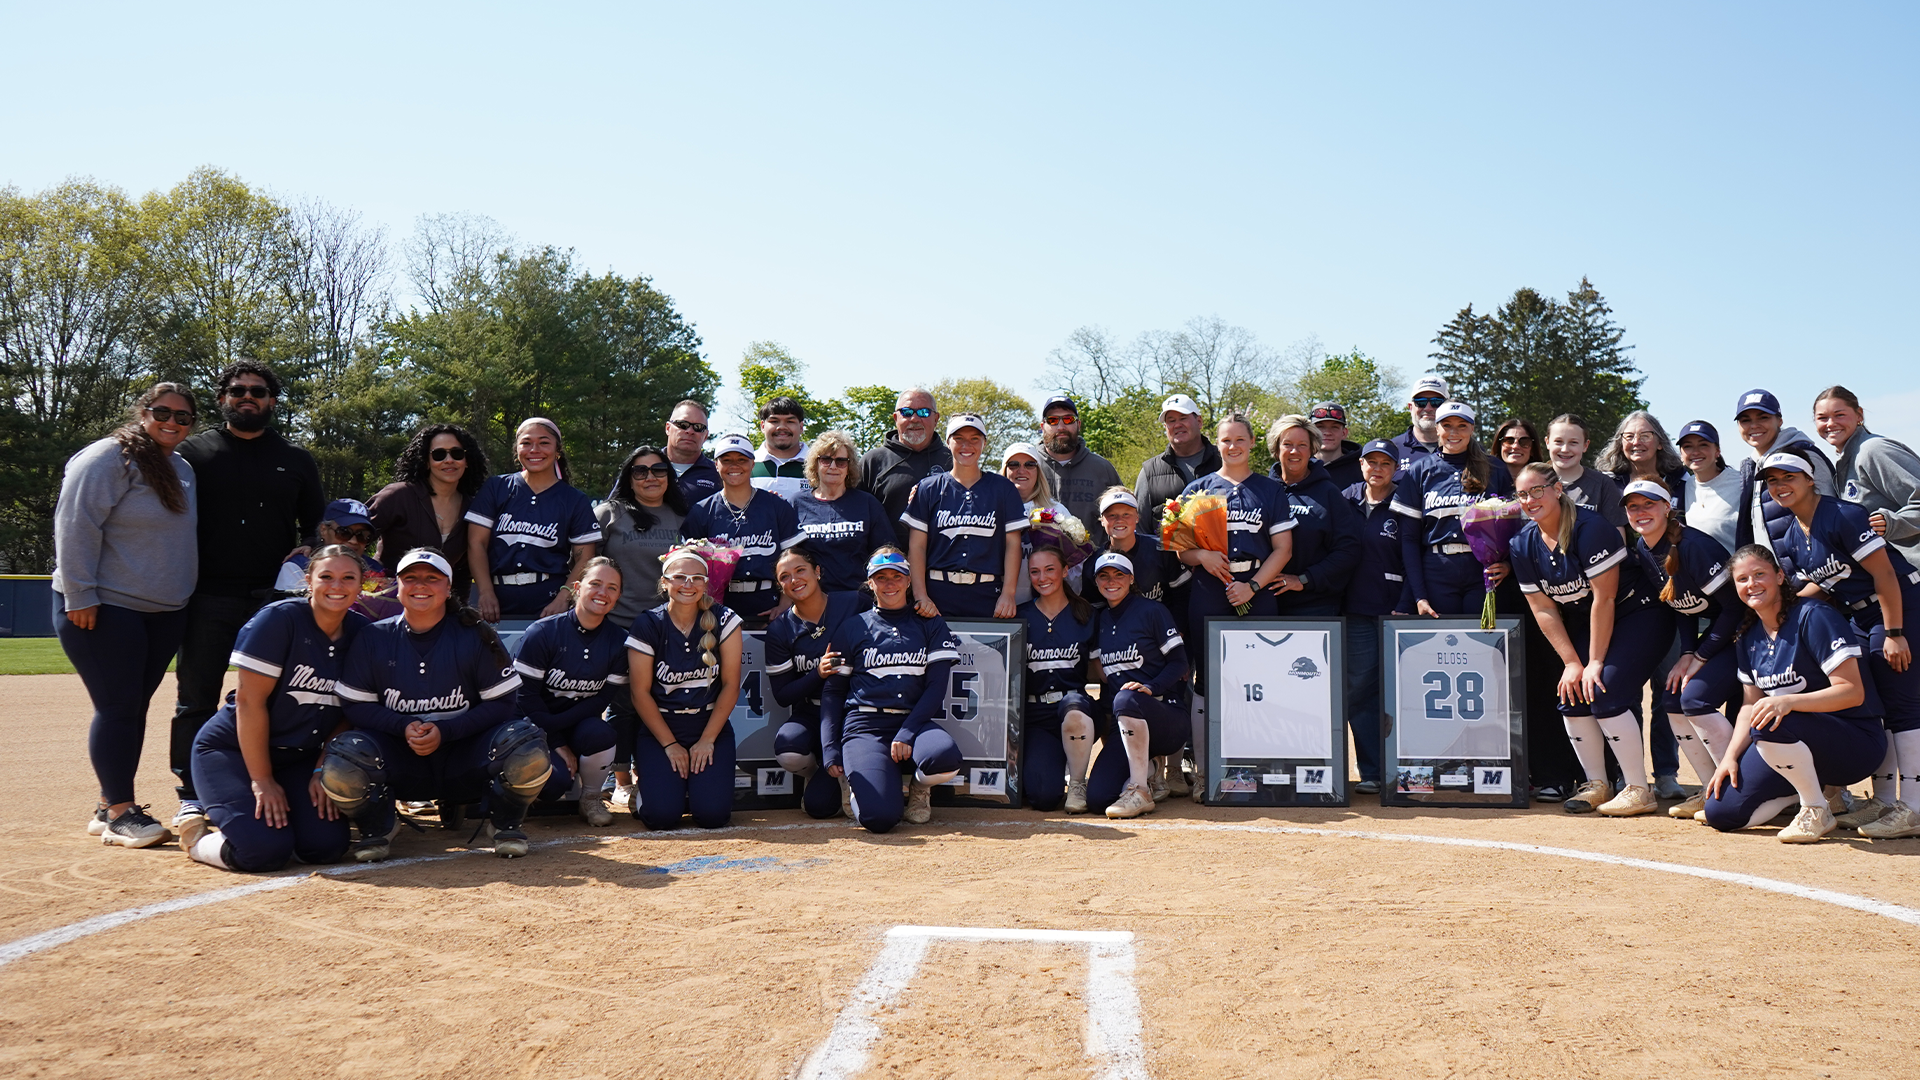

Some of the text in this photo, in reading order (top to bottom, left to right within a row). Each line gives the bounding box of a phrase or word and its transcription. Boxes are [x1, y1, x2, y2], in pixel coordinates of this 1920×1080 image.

[350, 503, 368, 517] M
[496, 513, 558, 540] Monmouth
[936, 510, 996, 528] Monmouth
[804, 521, 864, 533] ONMOUTH
[622, 529, 679, 544] MONMOUT
[1589, 549, 1609, 564] CAA
[863, 647, 927, 668] Monmouth
[1101, 643, 1141, 665] onmouth
[1437, 652, 1468, 665] BLOSS
[288, 664, 335, 692] Monm
[384, 685, 467, 713] Monmouth
[1244, 683, 1263, 702] 16
[1422, 670, 1485, 721] 28
[765, 771, 786, 786] M
[978, 771, 999, 786] M
[1304, 769, 1325, 784] M
[1482, 770, 1503, 785] M
